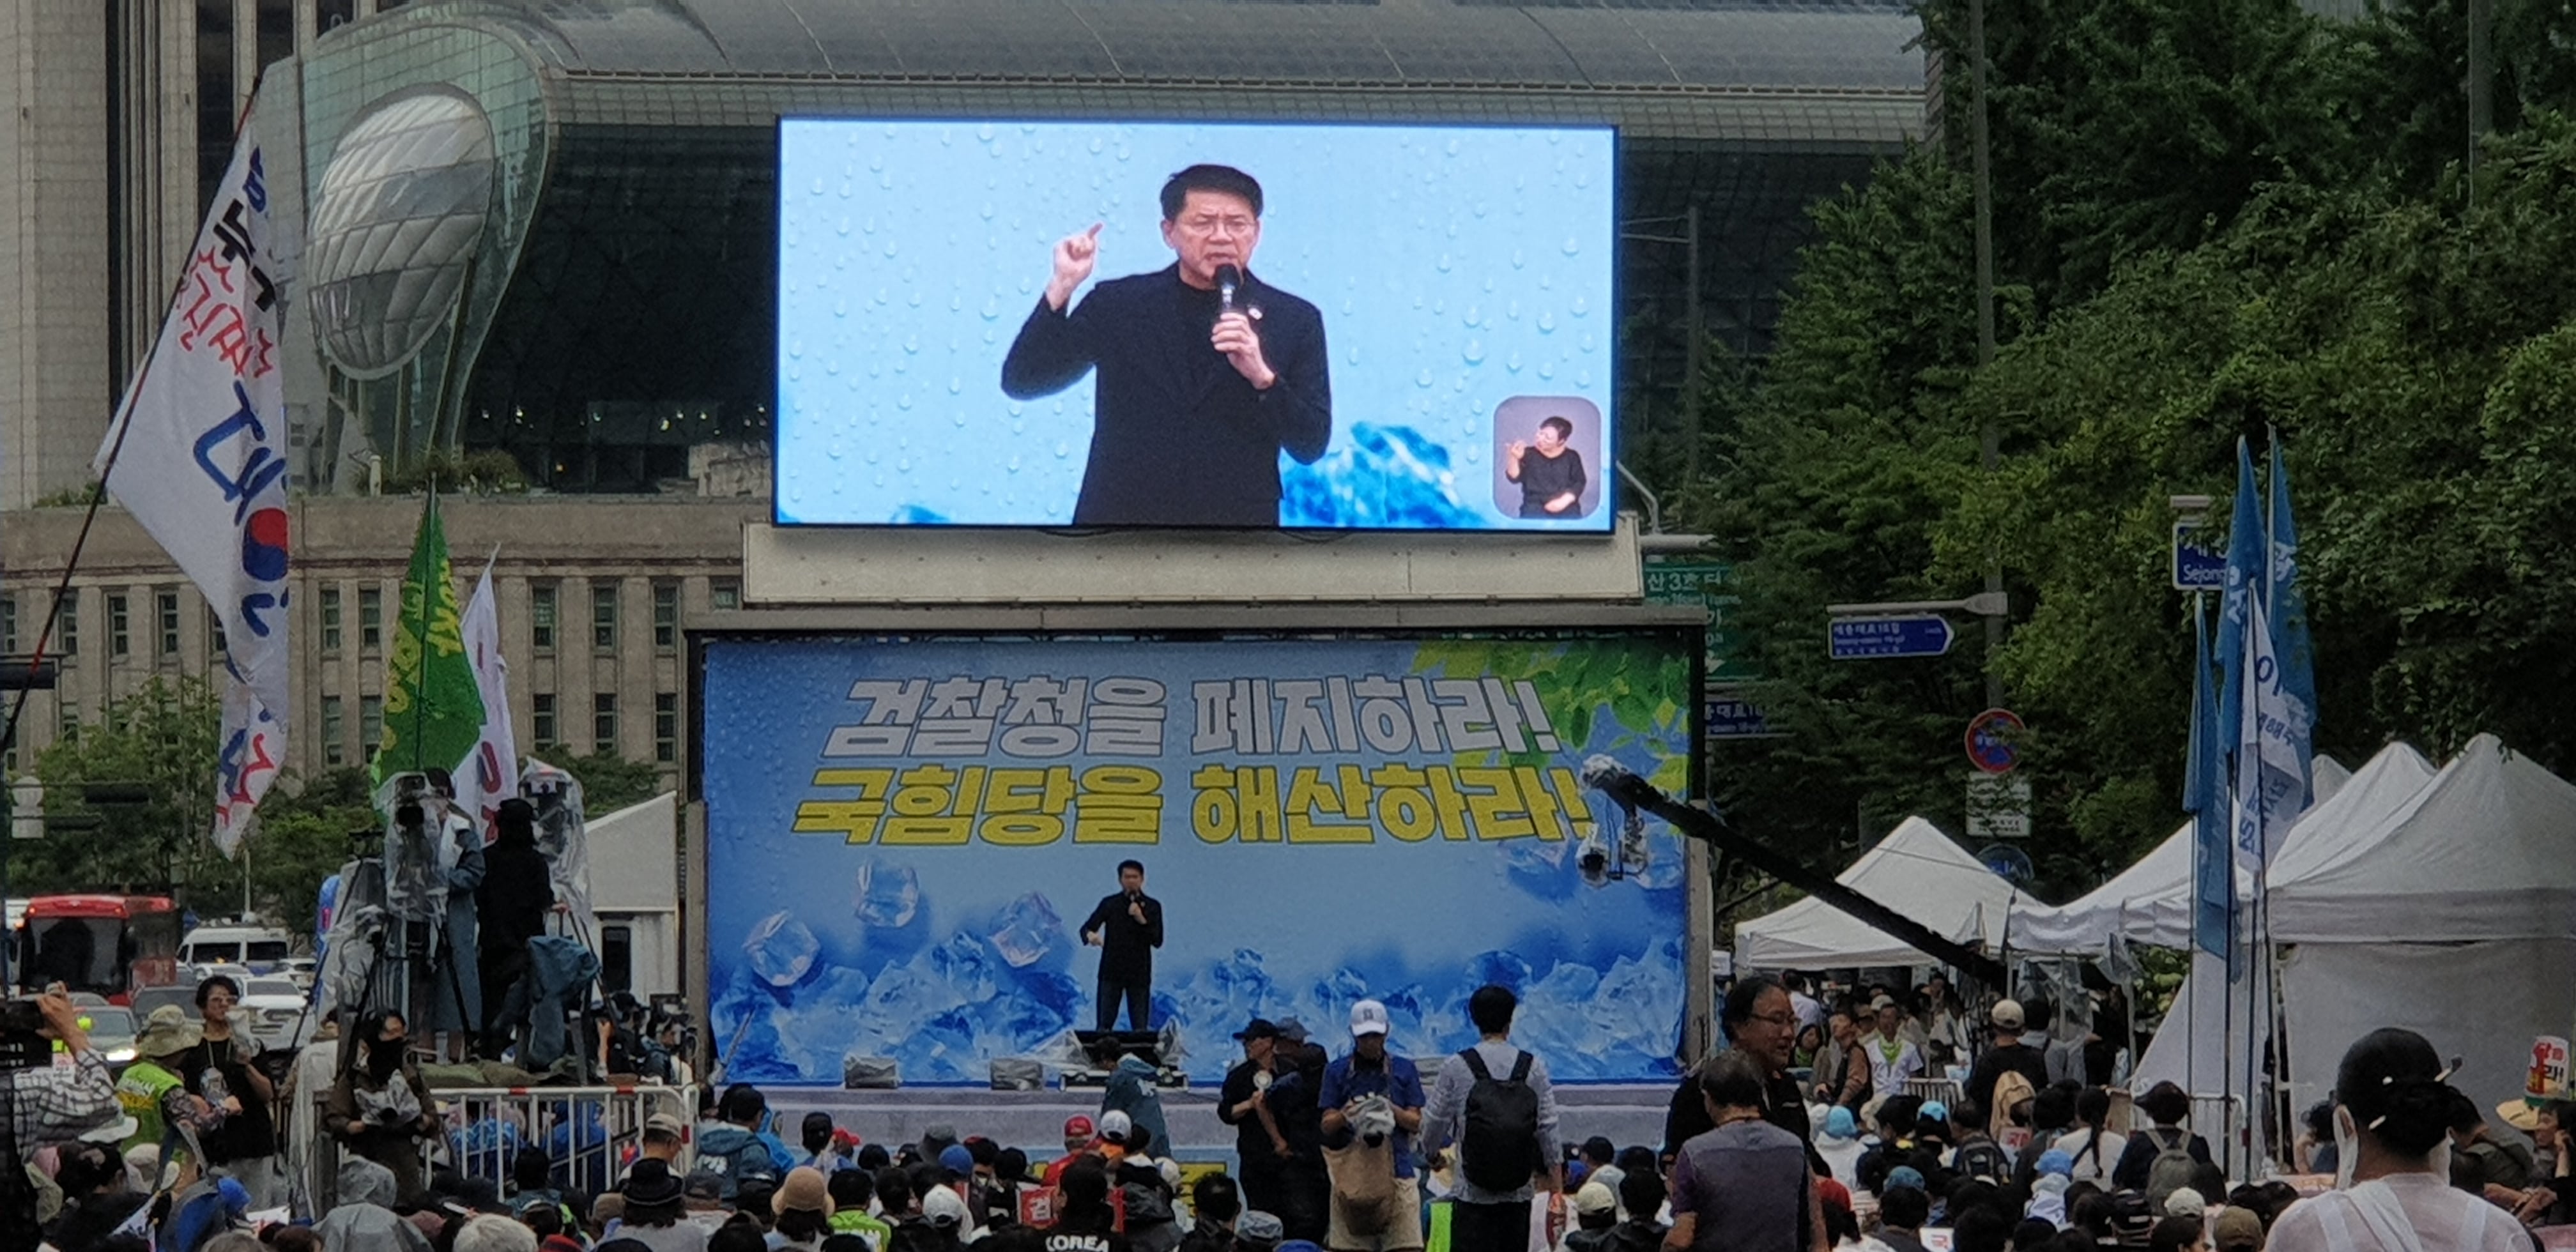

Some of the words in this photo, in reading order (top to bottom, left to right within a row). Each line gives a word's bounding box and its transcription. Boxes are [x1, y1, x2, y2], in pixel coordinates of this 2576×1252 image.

[820, 674, 1167, 758] 검찰청을
[1190, 673, 1560, 754] 폐지하라!
[793, 763, 1166, 846] 국힘당을
[1190, 763, 1593, 844] 해산하라!
